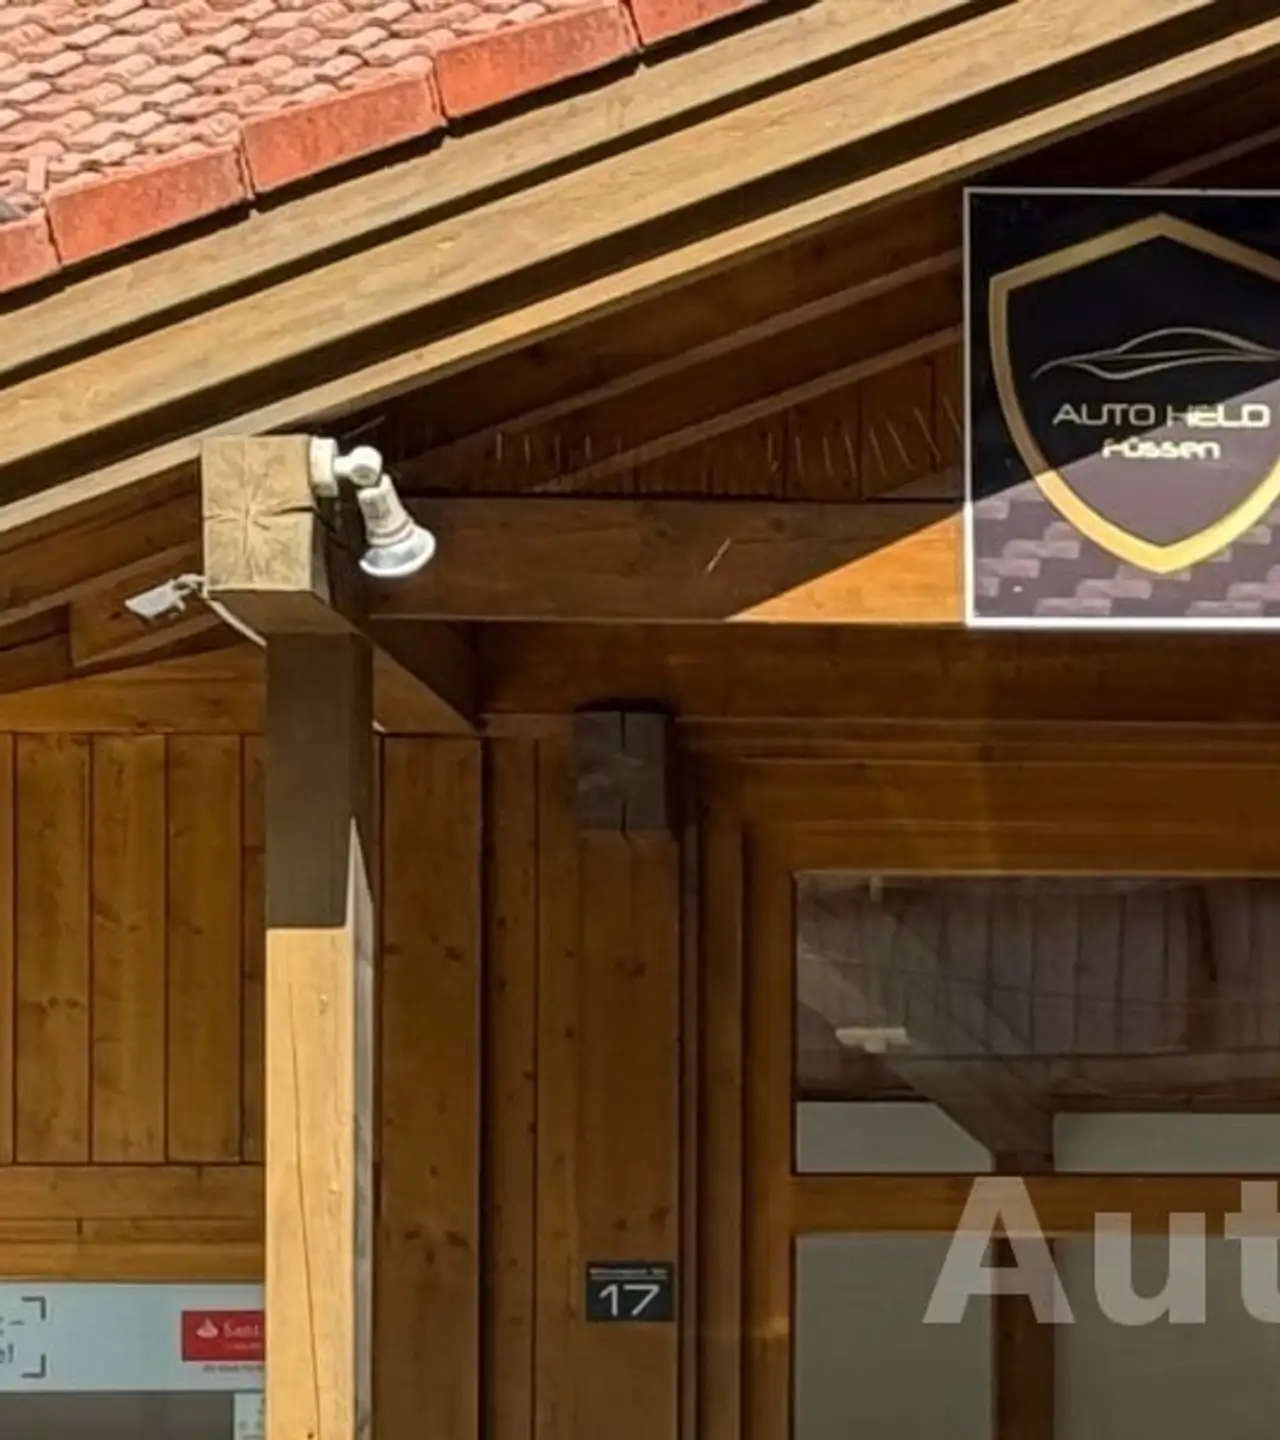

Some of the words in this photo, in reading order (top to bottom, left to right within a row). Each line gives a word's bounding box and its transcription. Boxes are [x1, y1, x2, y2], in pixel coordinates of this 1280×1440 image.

[1052, 403, 1155, 427] AUTO
[1166, 403, 1271, 428] HELD
[599, 1283, 660, 1317] 17
